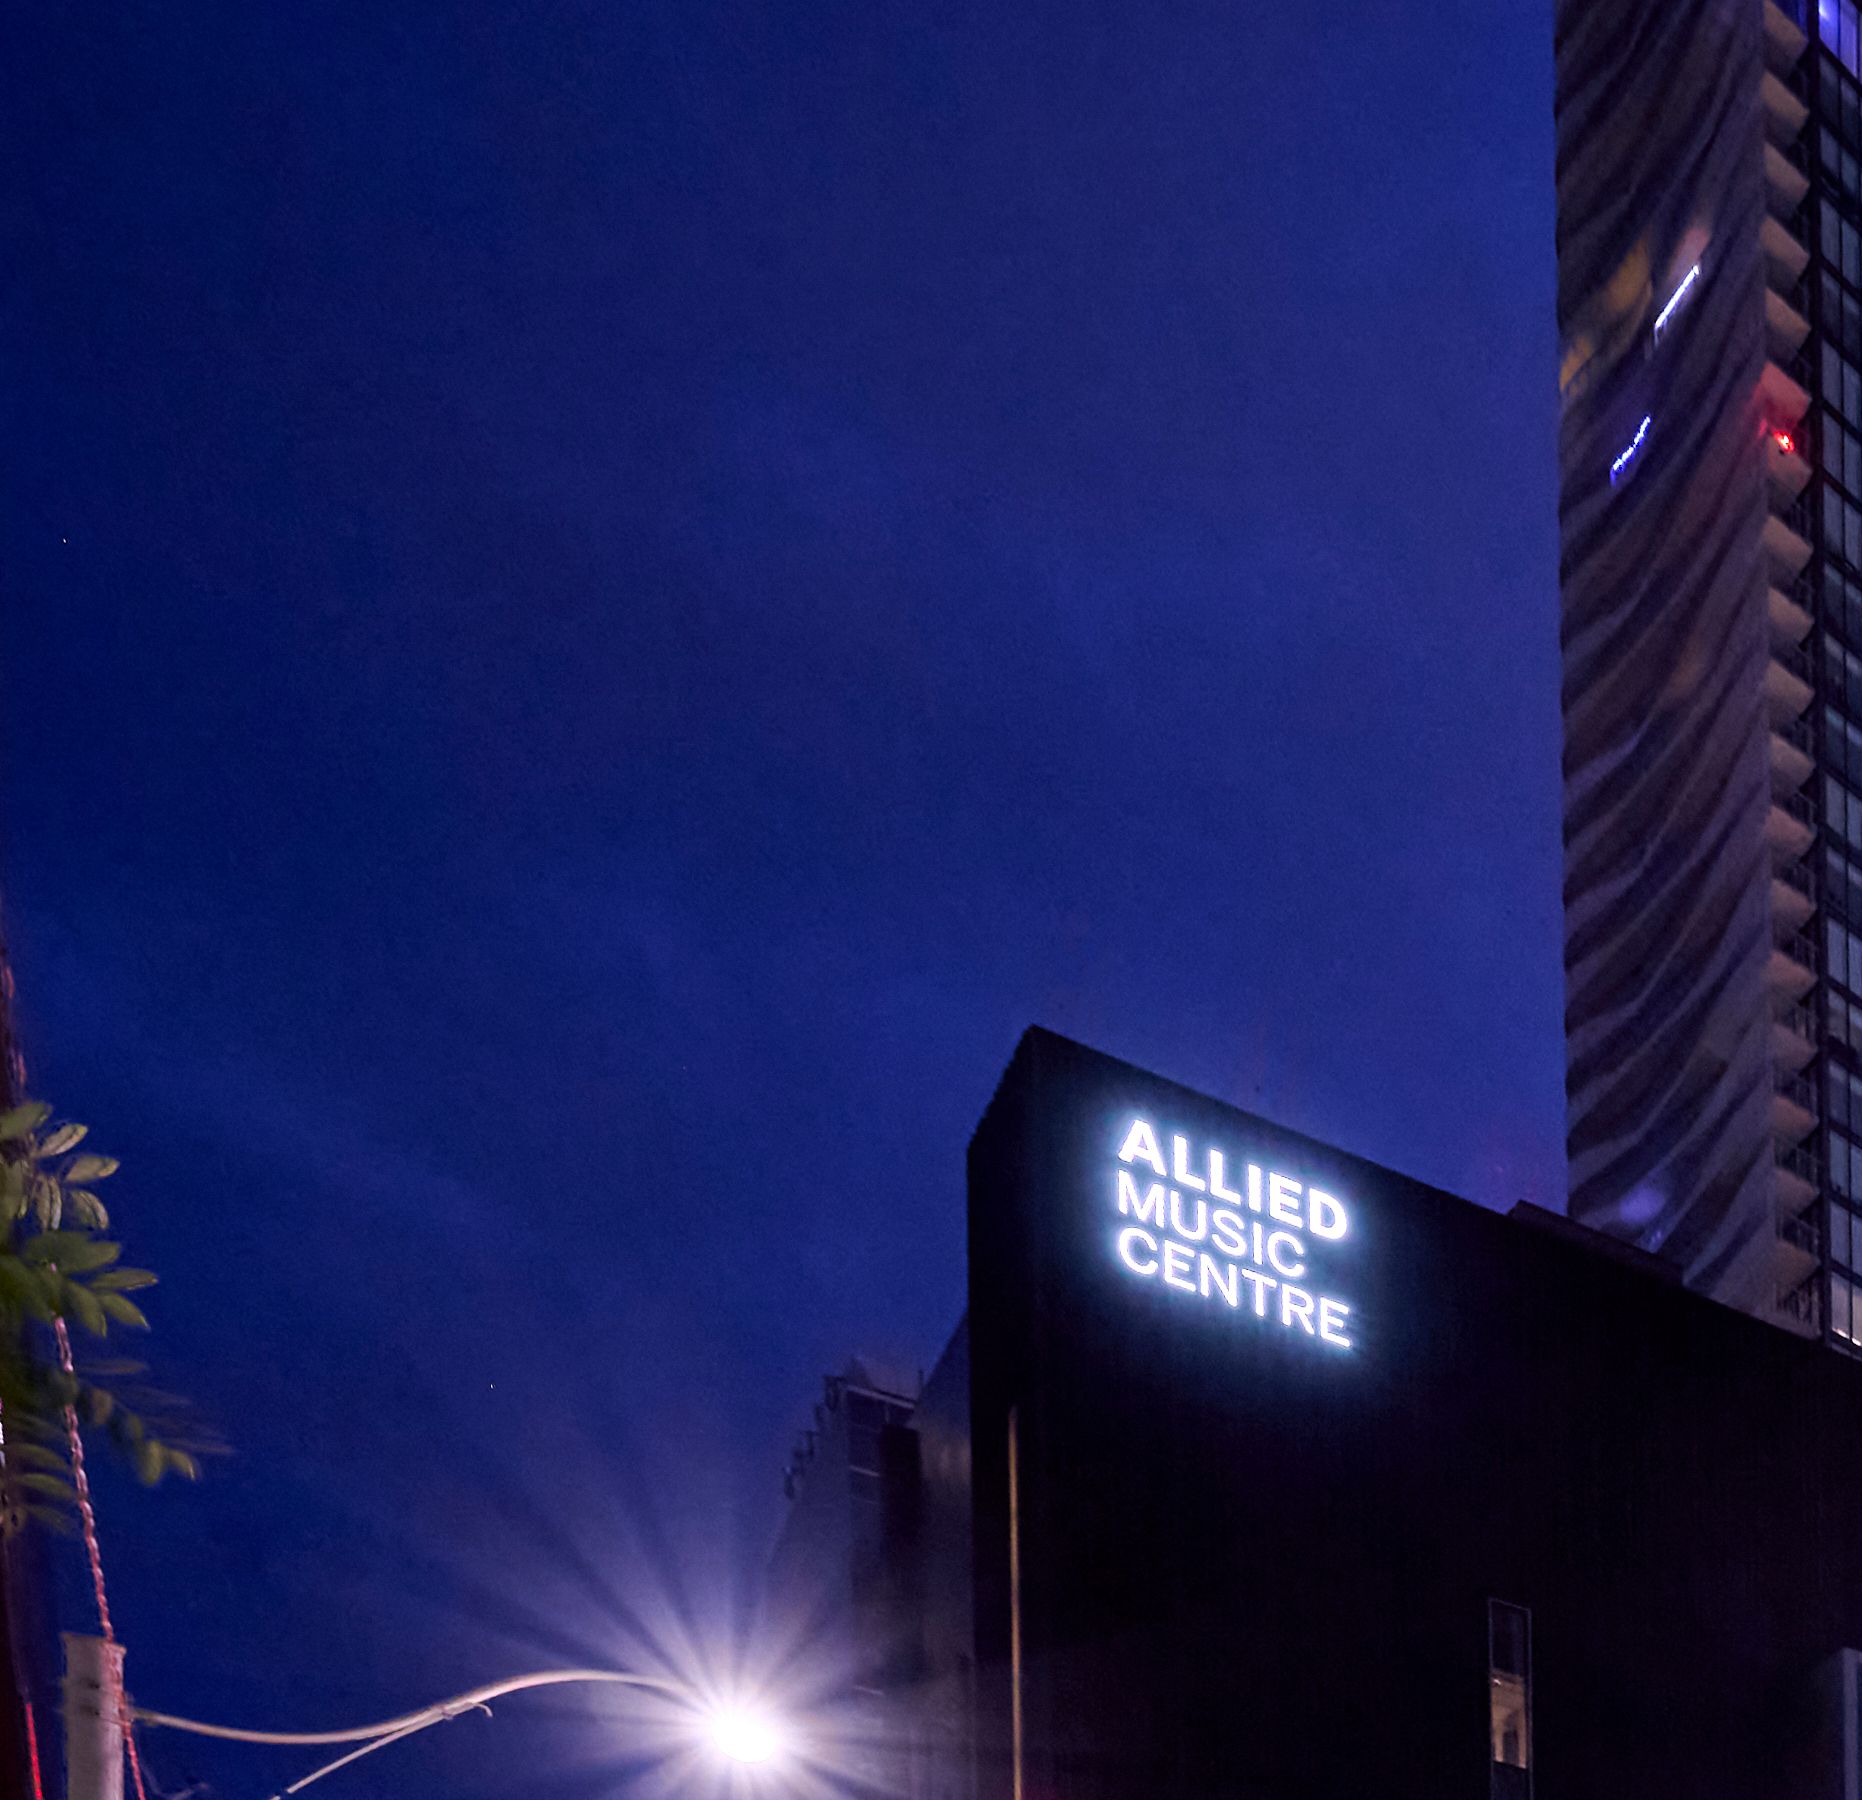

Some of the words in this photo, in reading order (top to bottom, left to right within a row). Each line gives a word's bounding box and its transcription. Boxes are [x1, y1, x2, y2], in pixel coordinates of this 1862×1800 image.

[1117, 1118, 1348, 1240] ALLIED
[1117, 1168, 1305, 1278] MUSIC
[1118, 1226, 1351, 1348] CENTRE
